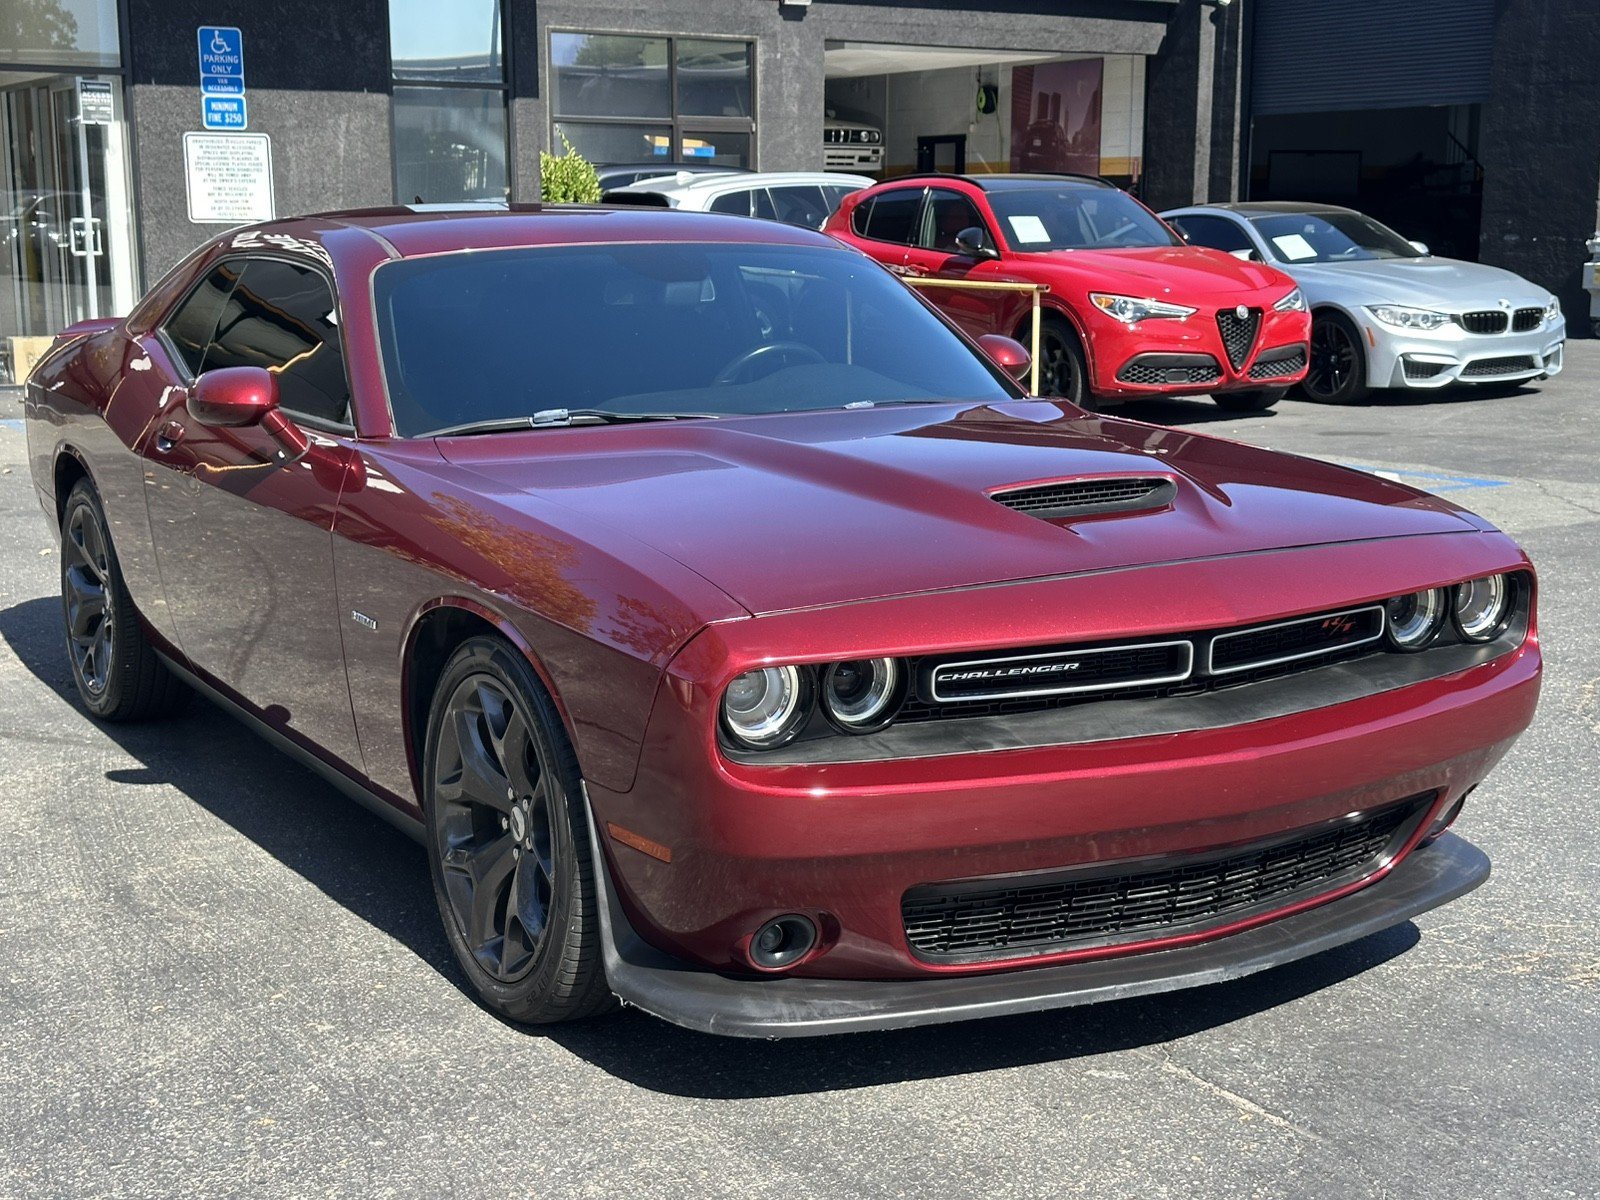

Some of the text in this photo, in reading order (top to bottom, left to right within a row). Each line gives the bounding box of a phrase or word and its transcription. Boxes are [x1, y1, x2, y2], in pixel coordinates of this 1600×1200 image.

[203, 54, 239, 64] PARKING
[211, 65, 232, 74] ONLY
[210, 102, 238, 111] MINIMUM
[207, 112, 242, 123] FINE $250
[1321, 614, 1356, 636] R/T
[937, 662, 1080, 682] CHALLENGER
